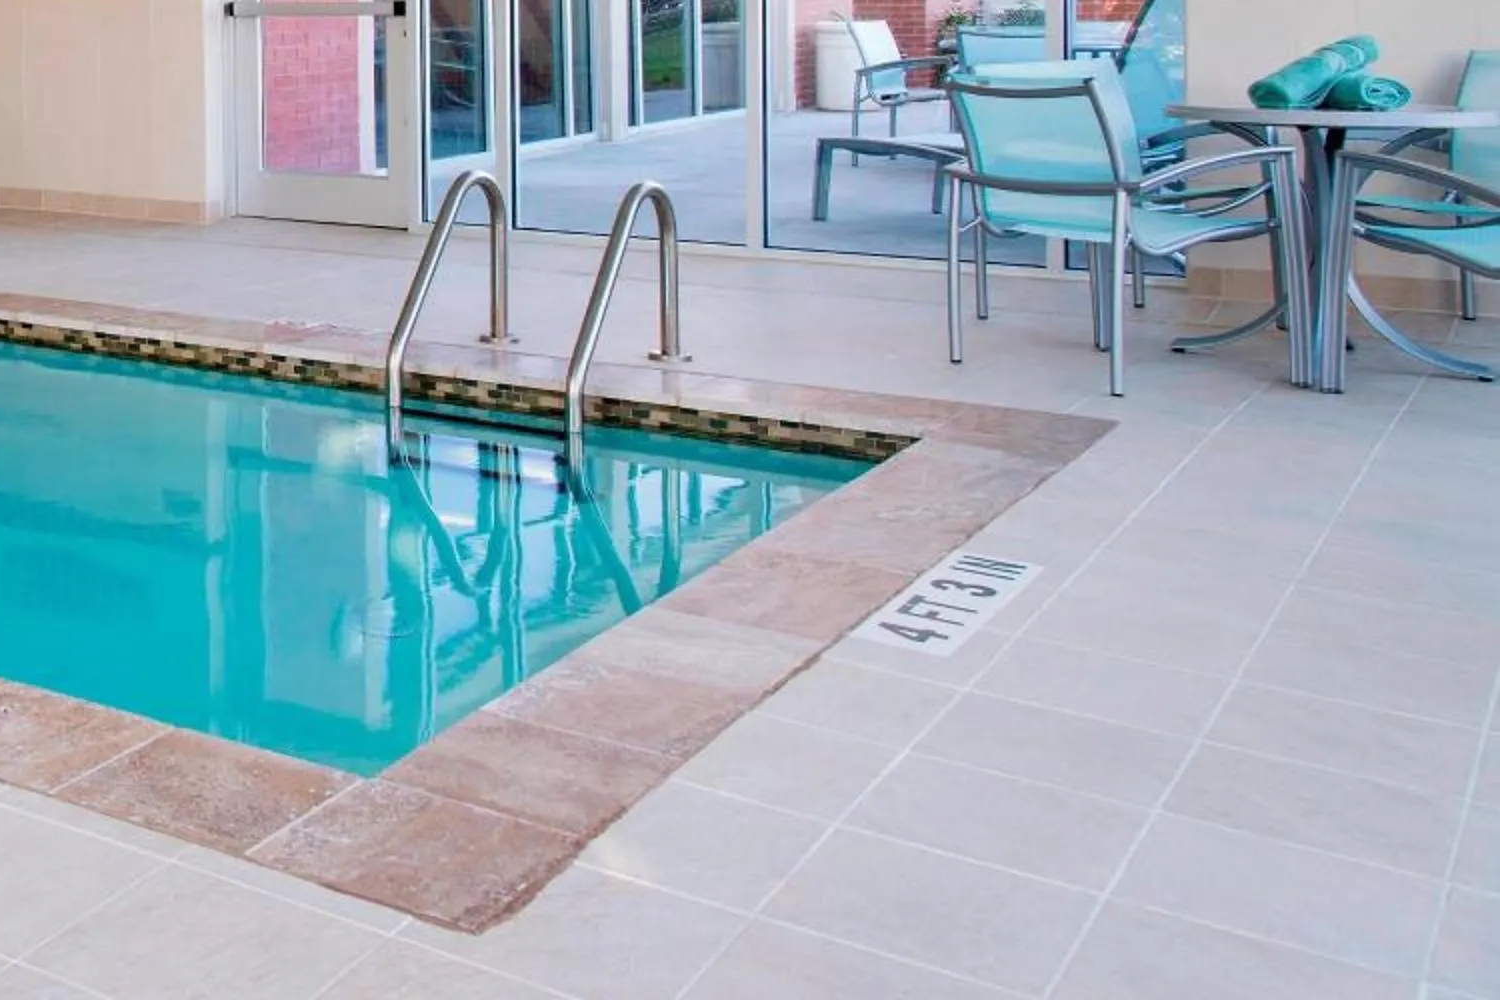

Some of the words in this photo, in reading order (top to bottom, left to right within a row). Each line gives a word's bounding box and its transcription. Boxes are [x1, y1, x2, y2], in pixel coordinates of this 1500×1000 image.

[949, 555, 1028, 581] IN
[930, 578, 998, 598] 3
[895, 594, 980, 627] FT
[877, 621, 950, 643] 4
